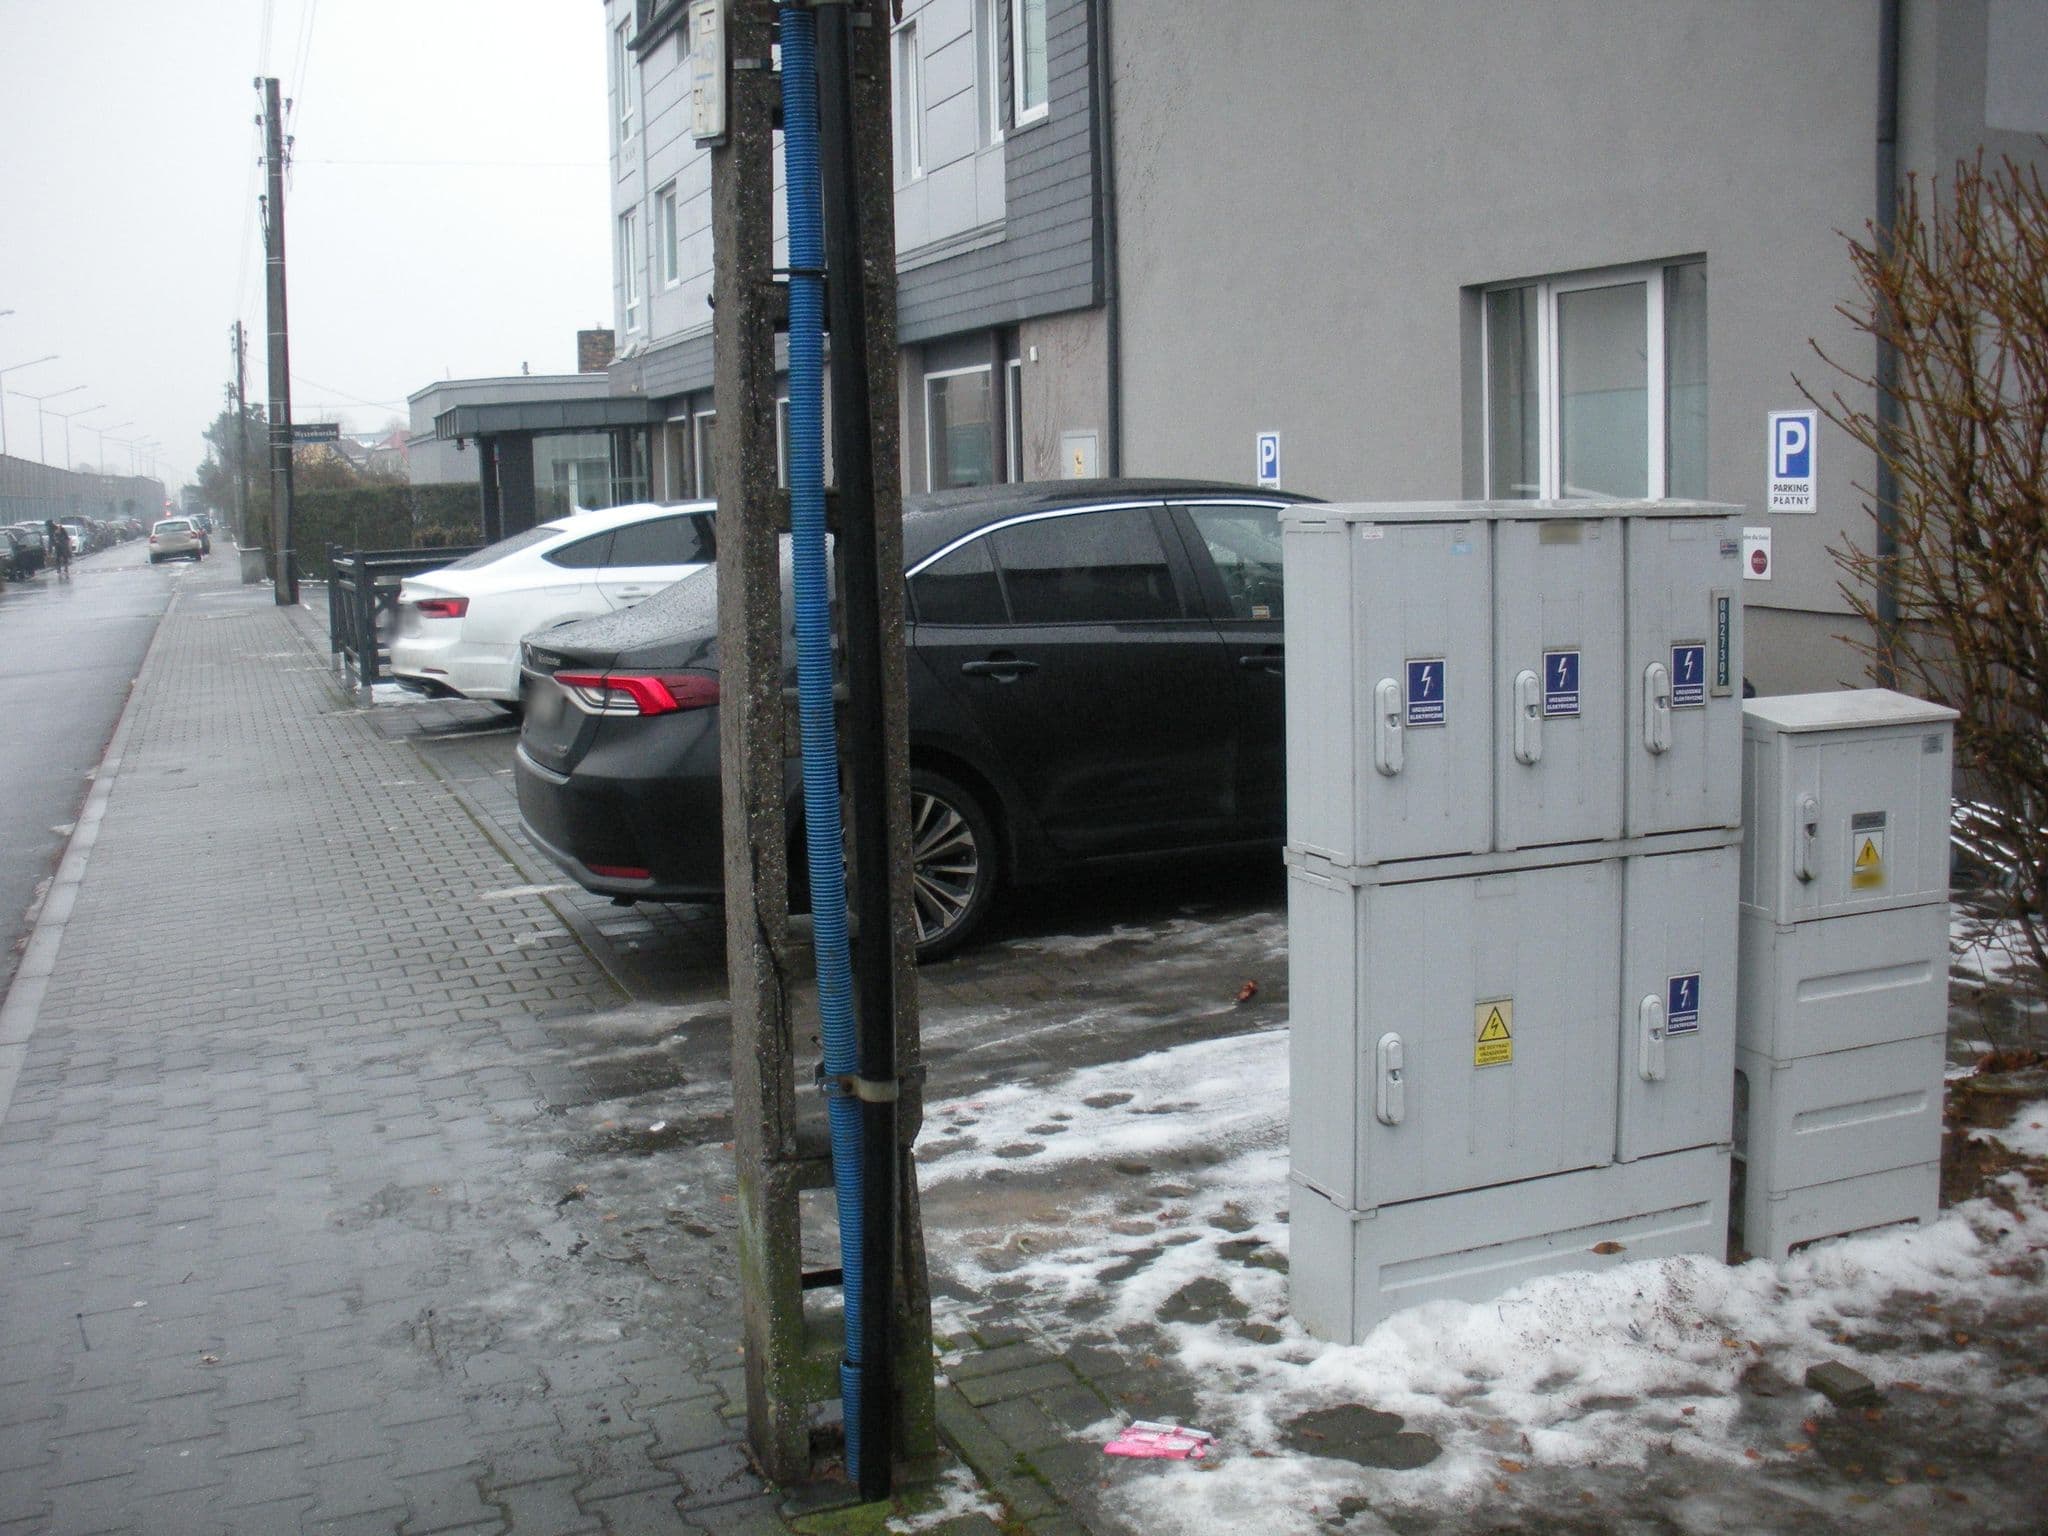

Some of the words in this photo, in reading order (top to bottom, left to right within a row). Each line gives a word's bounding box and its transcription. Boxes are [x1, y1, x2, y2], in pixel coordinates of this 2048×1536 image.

[1262, 439, 1275, 476] P
[1778, 421, 1807, 474] P
[1773, 484, 1809, 493] PARKING
[1773, 496, 1810, 505] PŁATNY
